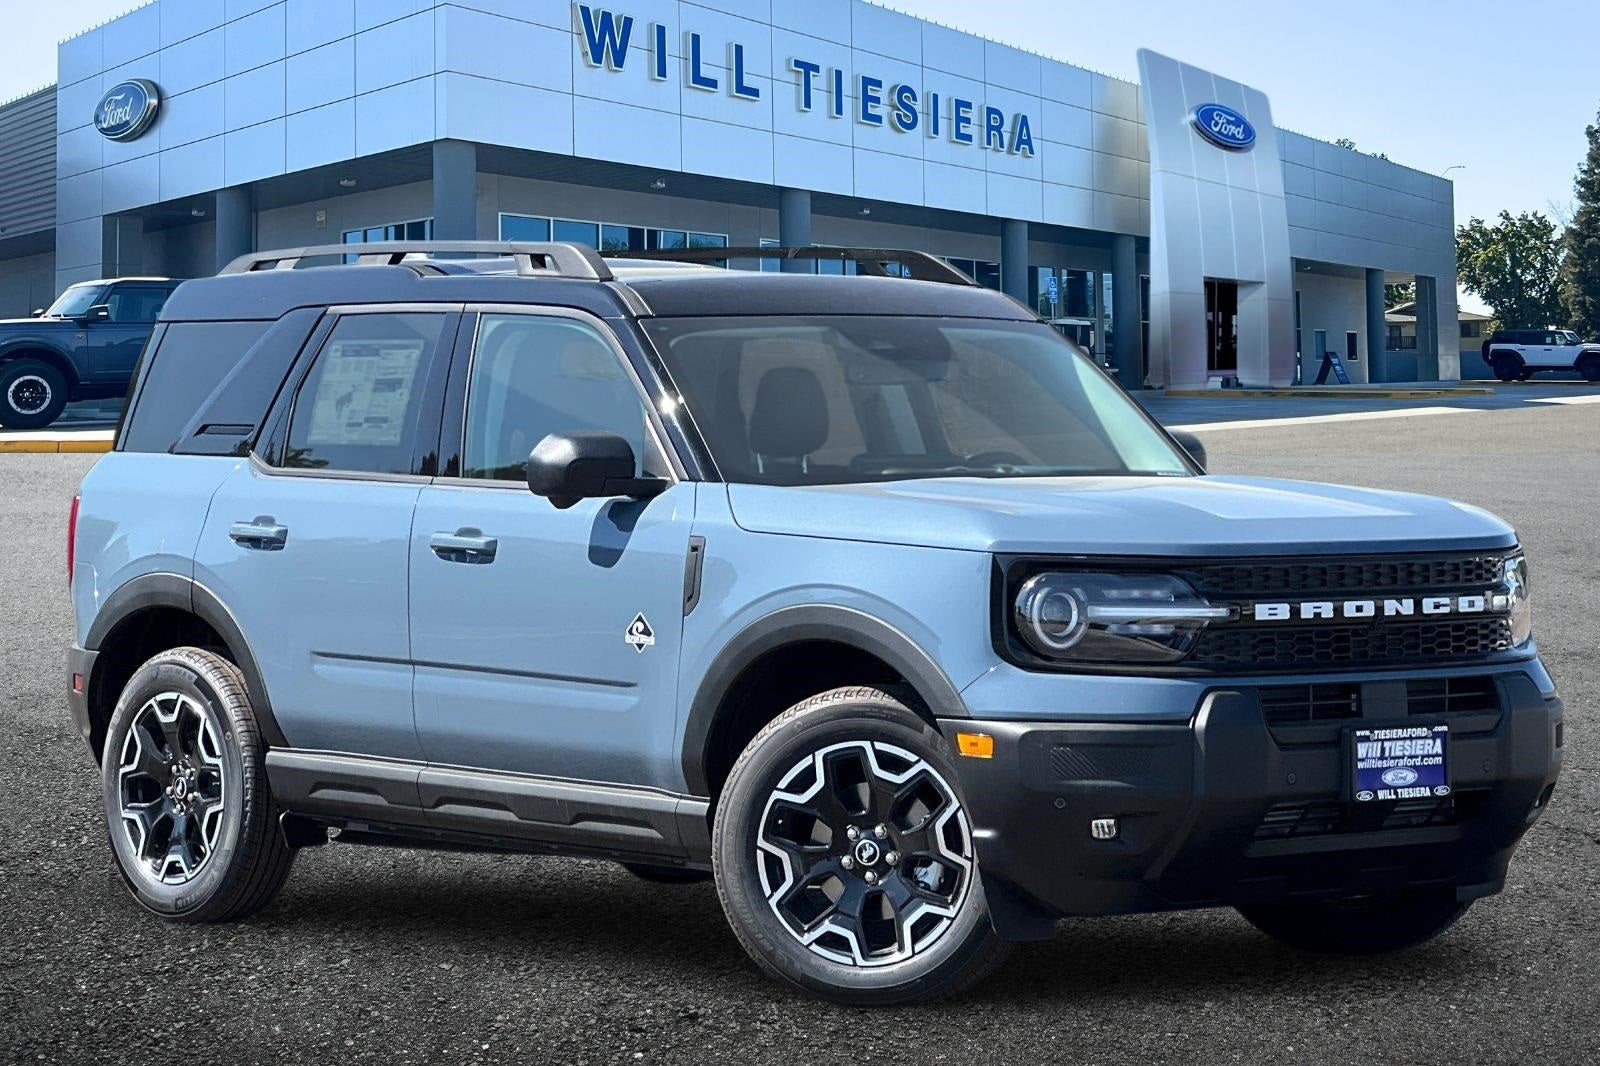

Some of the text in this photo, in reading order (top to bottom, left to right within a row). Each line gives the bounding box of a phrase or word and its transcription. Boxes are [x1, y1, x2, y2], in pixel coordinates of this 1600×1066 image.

[577, 3, 1036, 157] WILL TIESIERA
[101, 93, 133, 128] Ford
[1211, 111, 1245, 139] Ford
[1254, 595, 1485, 620] BRONCO
[1373, 728, 1427, 739] TIESIERAFORD
[1383, 738, 1442, 757] TIESIERA
[1357, 756, 1442, 769] willtiesieraford.com
[1377, 787, 1431, 800] WILL TIESIERA
